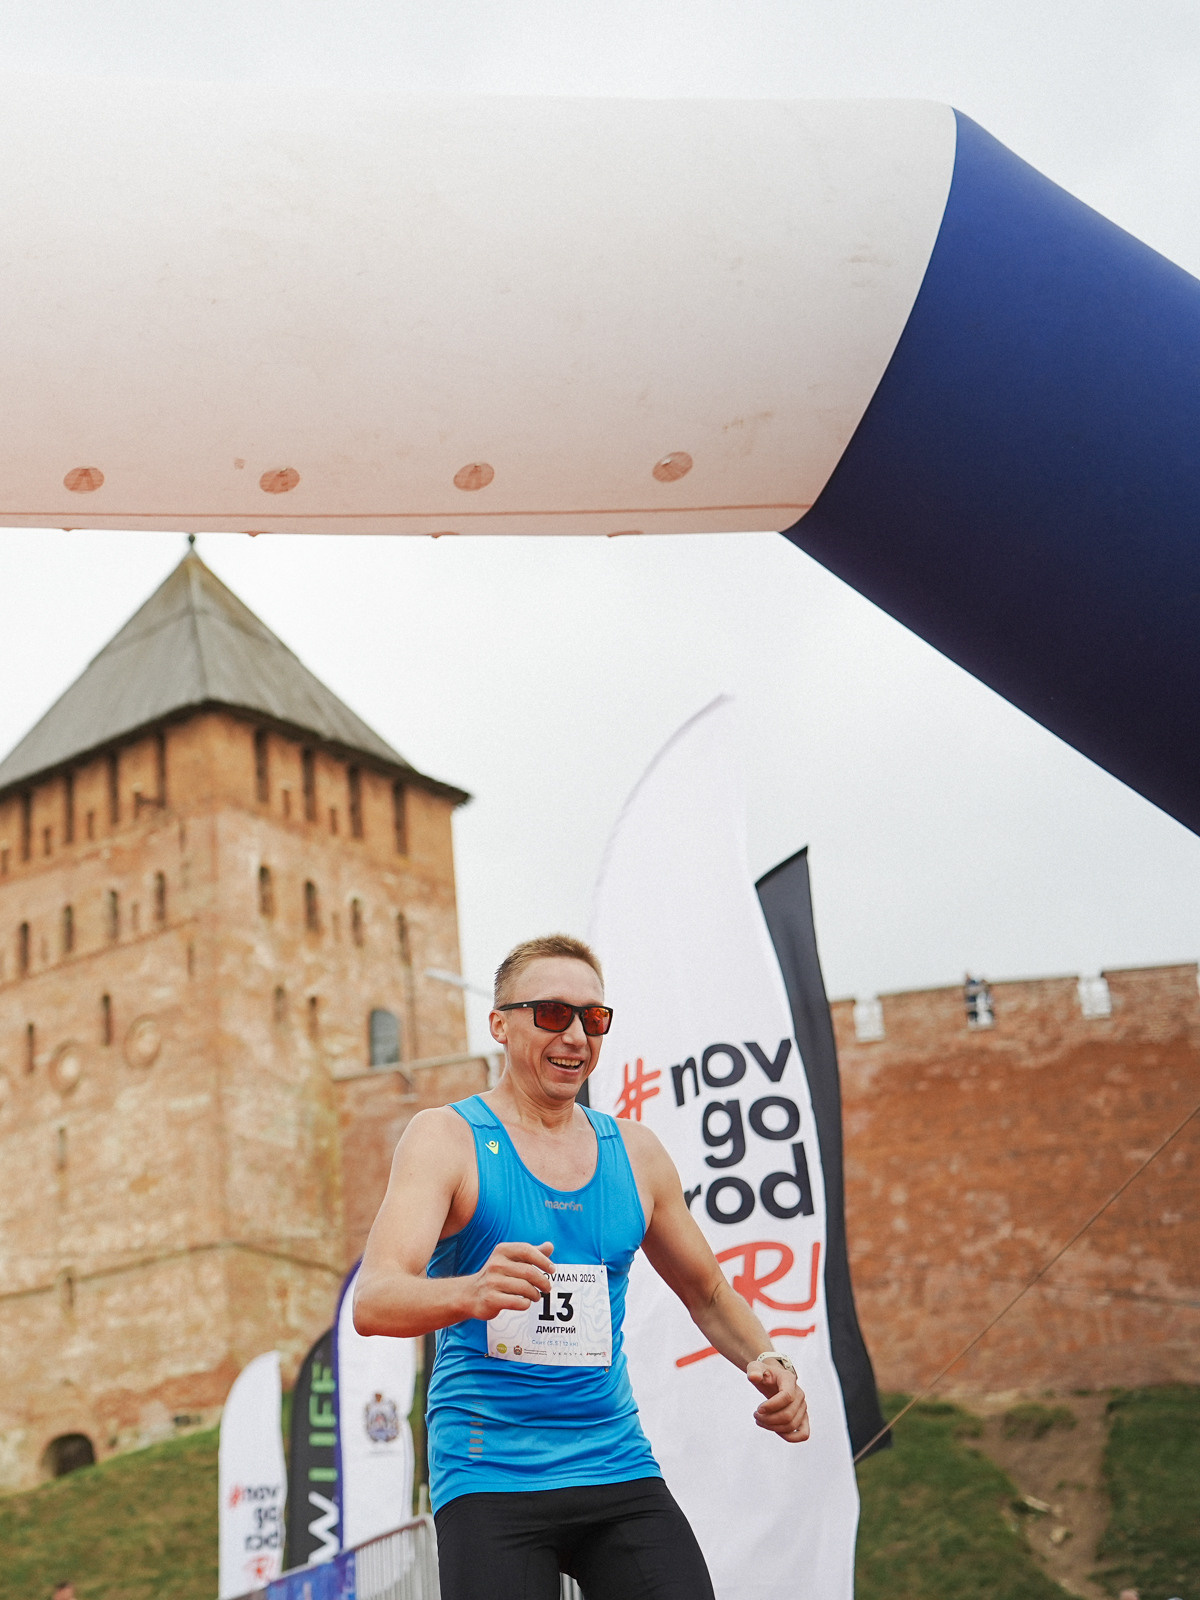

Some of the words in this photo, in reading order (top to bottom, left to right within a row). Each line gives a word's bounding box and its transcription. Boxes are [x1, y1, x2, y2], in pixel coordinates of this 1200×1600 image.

[702, 1095, 800, 1169] go
[579, 1274, 597, 1284] 2023
[538, 1292, 574, 1322] 13
[536, 1325, 576, 1334] ДМИТРИЙ
